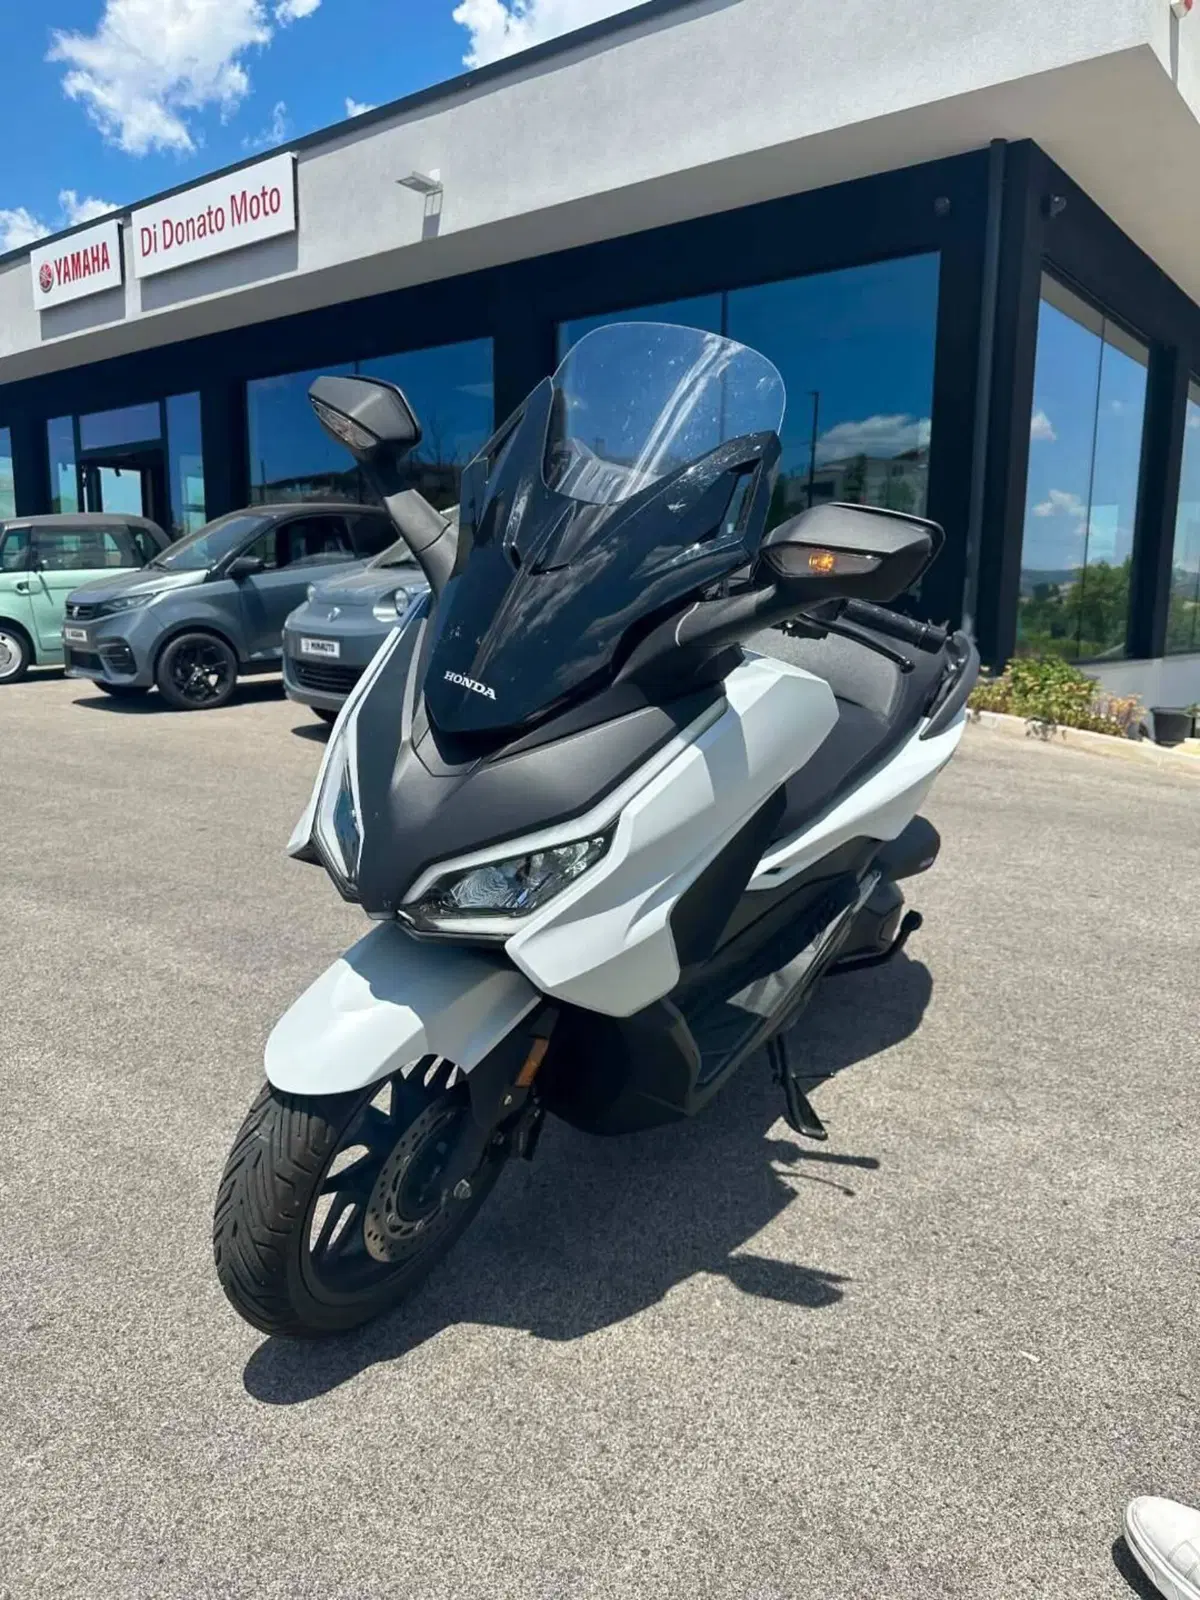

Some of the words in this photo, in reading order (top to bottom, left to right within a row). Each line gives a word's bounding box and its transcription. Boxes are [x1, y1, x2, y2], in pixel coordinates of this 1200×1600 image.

[141, 224, 157, 257] Di
[163, 205, 224, 249] Donato
[230, 187, 280, 227] Moto
[54, 242, 110, 286] YAMAHA
[444, 670, 497, 700] HONDA
